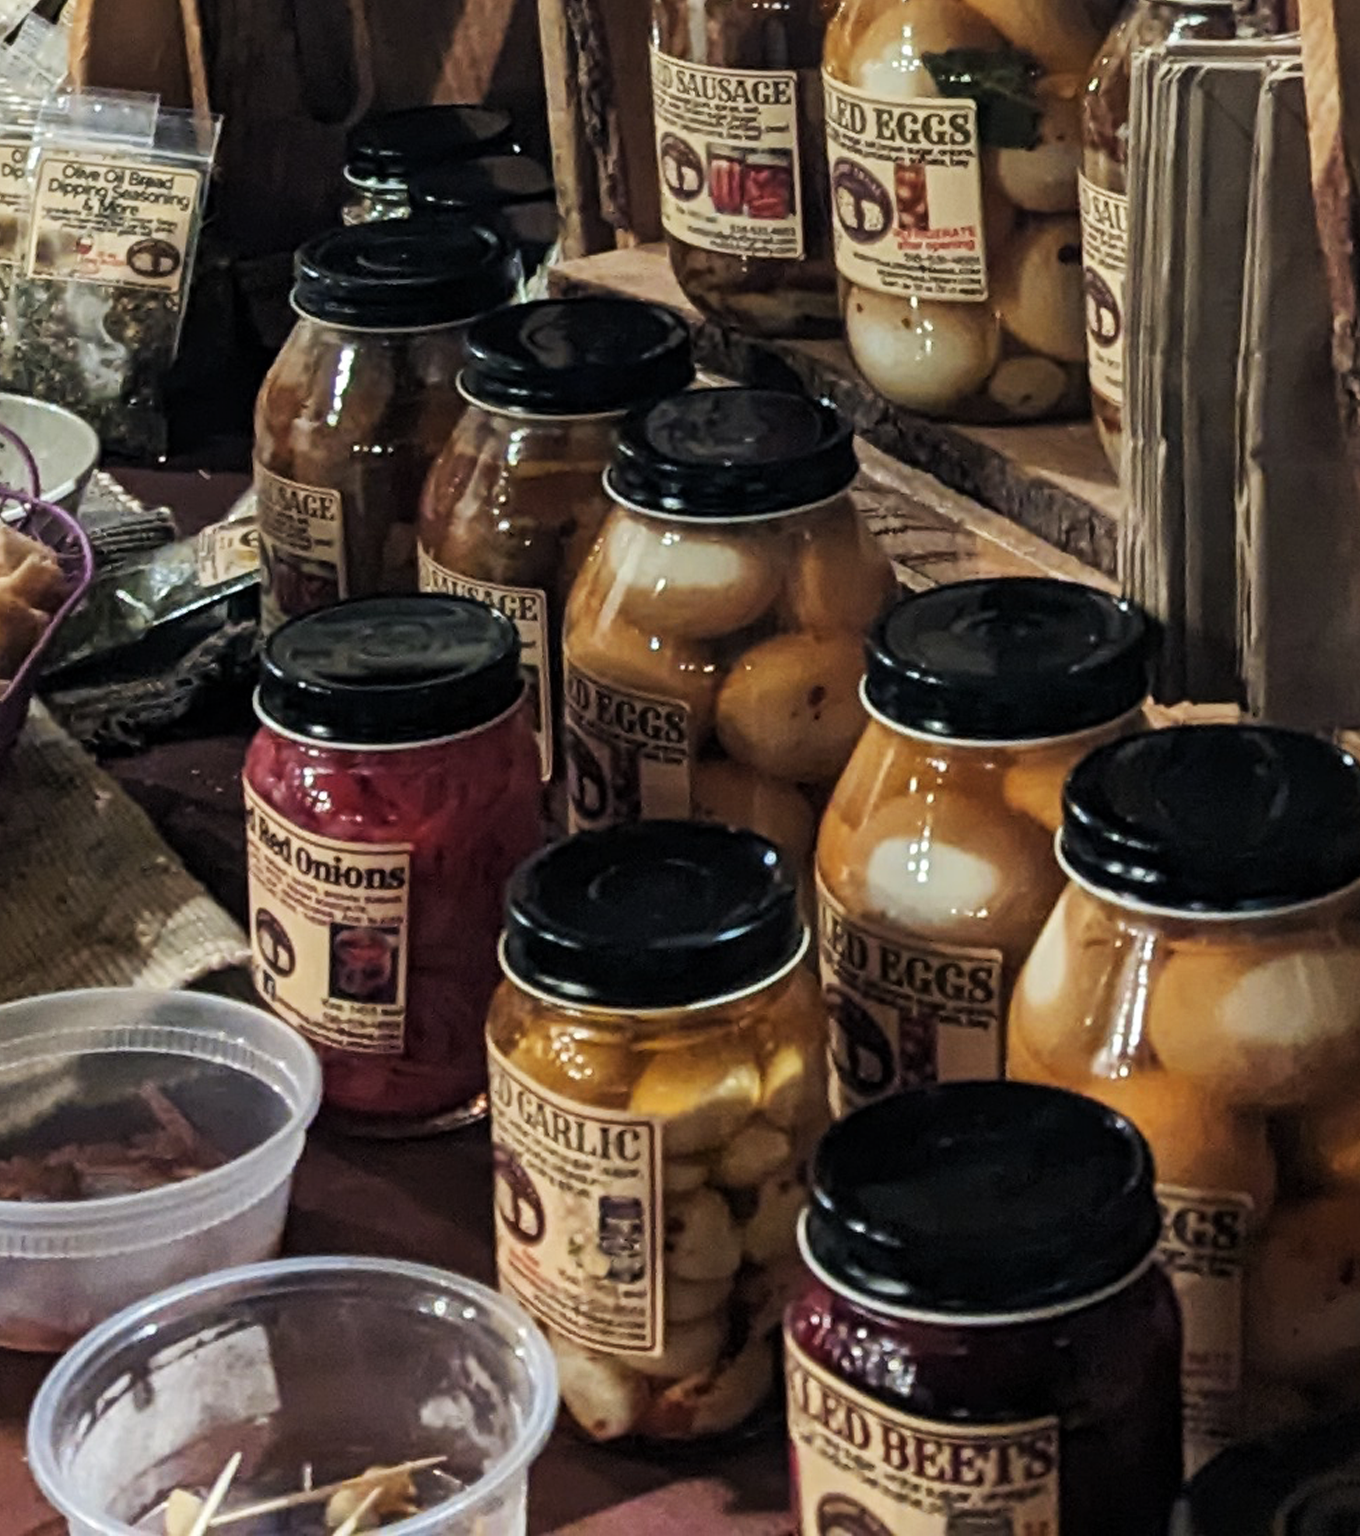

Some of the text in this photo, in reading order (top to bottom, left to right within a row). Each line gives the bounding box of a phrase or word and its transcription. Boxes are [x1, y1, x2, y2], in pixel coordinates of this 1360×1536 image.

[675, 68, 792, 106] SAUSAGE
[872, 106, 974, 147] EGGS
[48, 177, 190, 212] Dipping Seasoning
[62, 163, 174, 190] Olive Oil Bread
[97, 199, 140, 216] More
[278, 485, 336, 522] SAGE
[595, 688, 686, 744] EGGS
[295, 846, 407, 891] Onions
[879, 944, 995, 1005] EGGS
[517, 1088, 643, 1164] GARLIC
[881, 1422, 1054, 1488] BEETS
